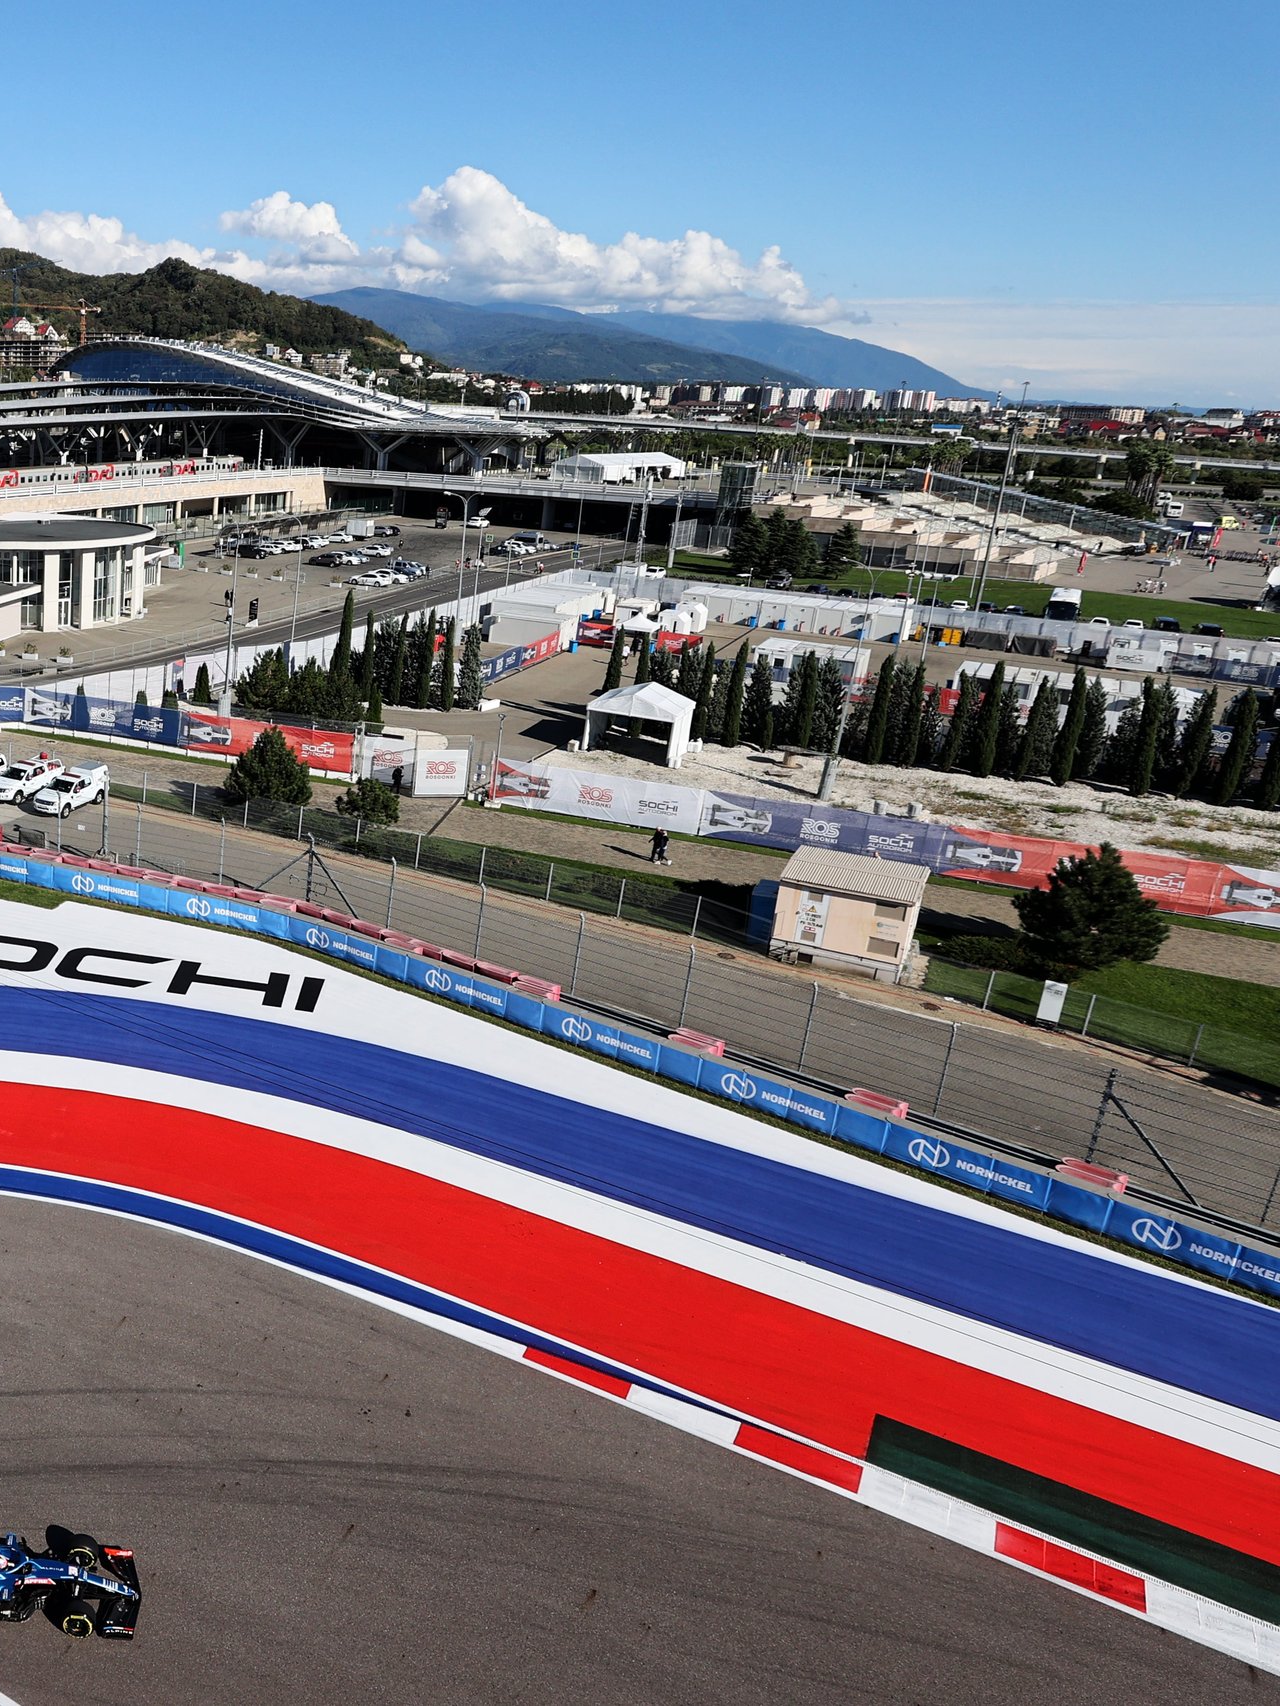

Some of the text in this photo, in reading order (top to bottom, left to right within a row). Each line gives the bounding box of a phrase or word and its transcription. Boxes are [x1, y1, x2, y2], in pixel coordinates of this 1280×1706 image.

[90, 706, 116, 722] ROS
[133, 718, 164, 729] SOCHI
[301, 743, 335, 755] SOCHI
[373, 748, 403, 765] ROS
[426, 760, 456, 775] ROS
[578, 784, 613, 803] ROS
[638, 799, 679, 812] SOCHI
[801, 818, 841, 838] ROS
[800, 832, 838, 844] ROSGONKI
[868, 834, 914, 849] SOCHI
[867, 842, 913, 854] AUTODROM
[1132, 873, 1185, 889] SOCHI
[1136, 882, 1183, 894] UTODROM
[97, 883, 139, 898] NORNICKEL
[214, 907, 257, 923] NORNICKEL
[333, 940, 374, 962] NORNICKEL
[455, 983, 503, 1006] NORNICKEL
[596, 1033, 652, 1059] NORNICKEL
[761, 1090, 826, 1121] NORNICKEL
[955, 1159, 1033, 1194] NORNICKEL
